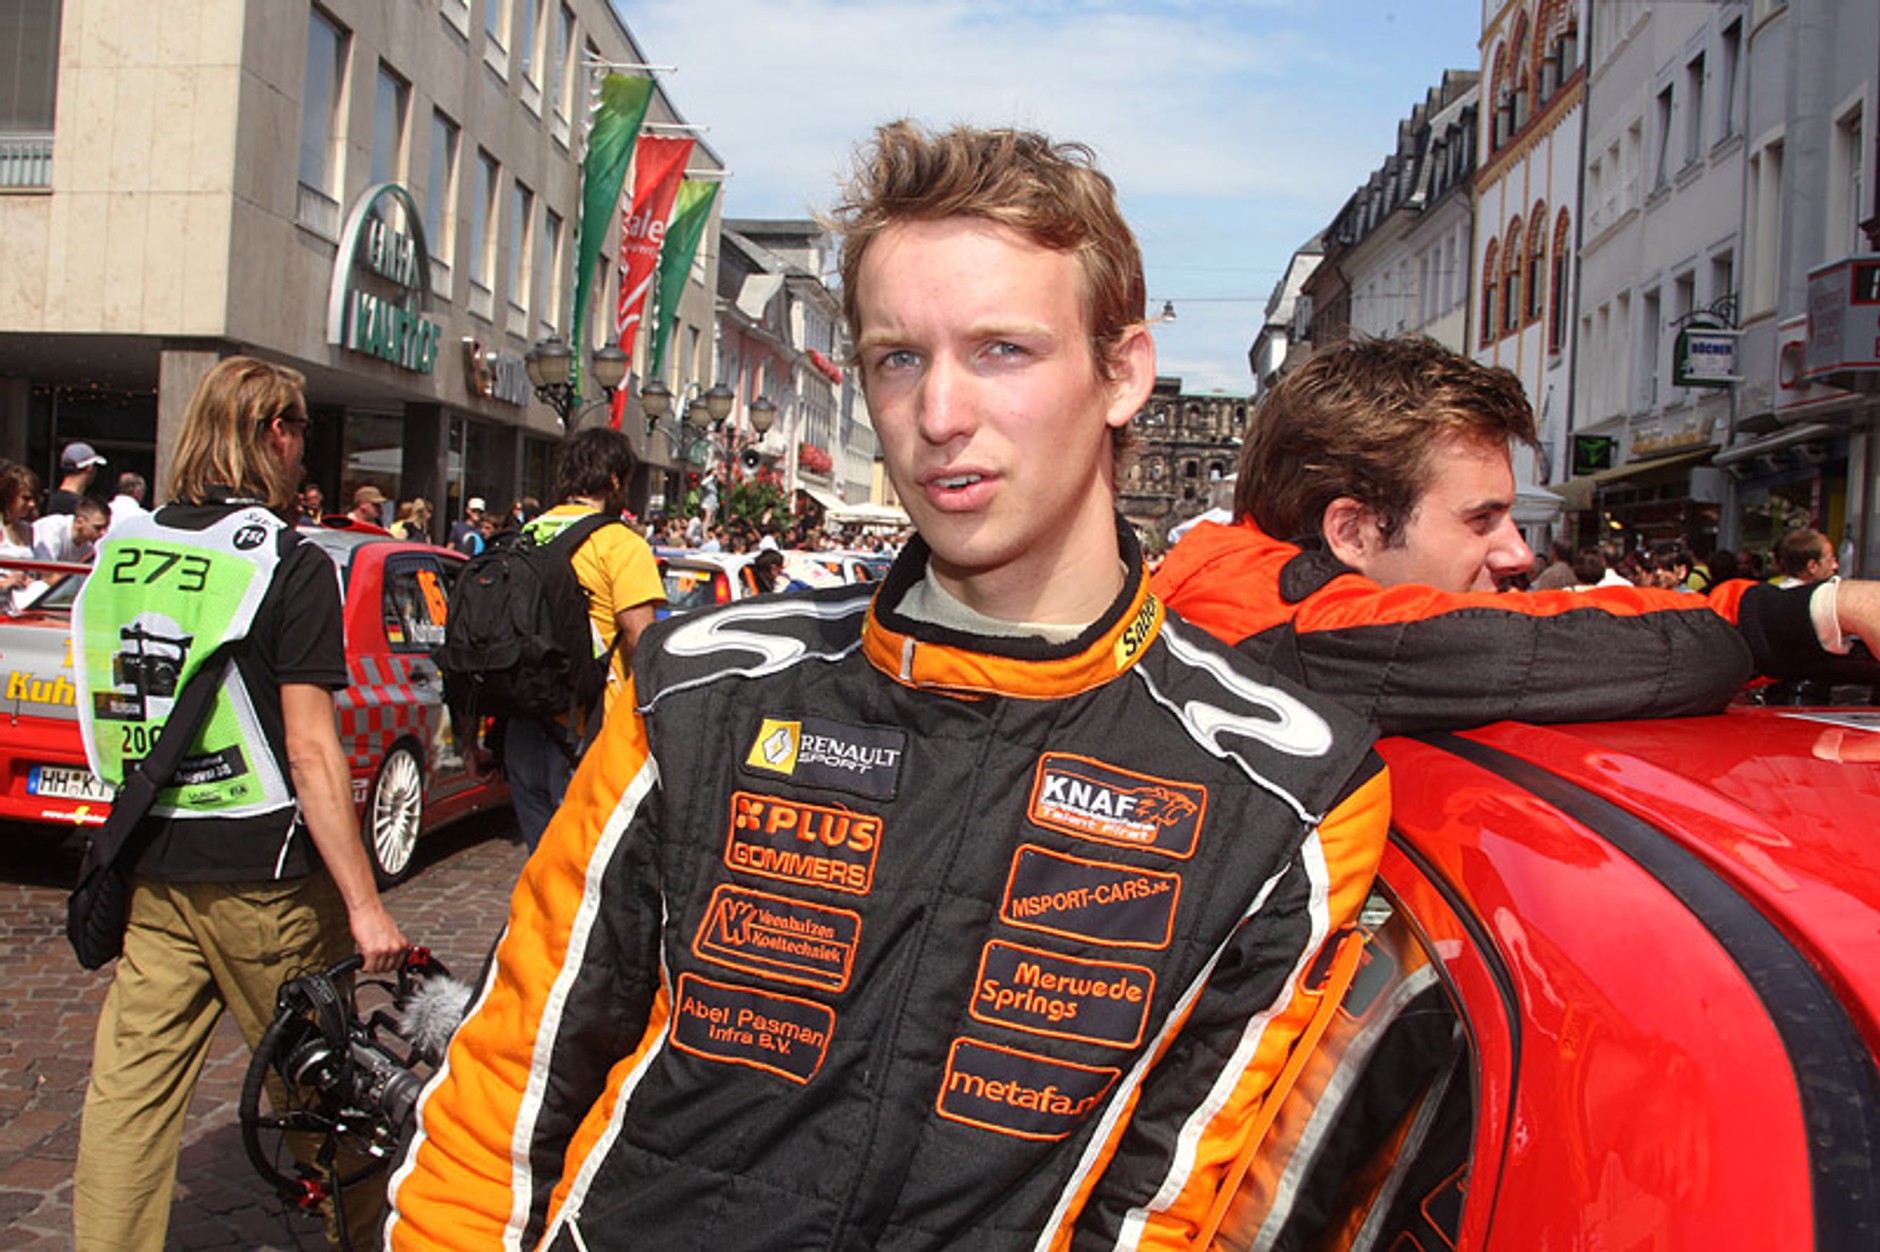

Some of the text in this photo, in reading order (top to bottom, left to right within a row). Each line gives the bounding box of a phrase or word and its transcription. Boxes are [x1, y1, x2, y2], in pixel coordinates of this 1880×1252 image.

[112, 547, 211, 592] 273
[798, 751, 872, 774] SPORT
[801, 734, 900, 767] RENAULT
[40, 769, 69, 793] HH
[1042, 774, 1138, 817] KNAF
[765, 805, 876, 852] PLUS
[1041, 805, 1097, 832] Talent
[733, 841, 867, 888] GOMMERS
[980, 979, 1079, 1022] Springs
[1013, 961, 1144, 1003] Merwede
[682, 996, 824, 1048] Abel Pasman
[709, 1024, 792, 1056] Infra B.V.
